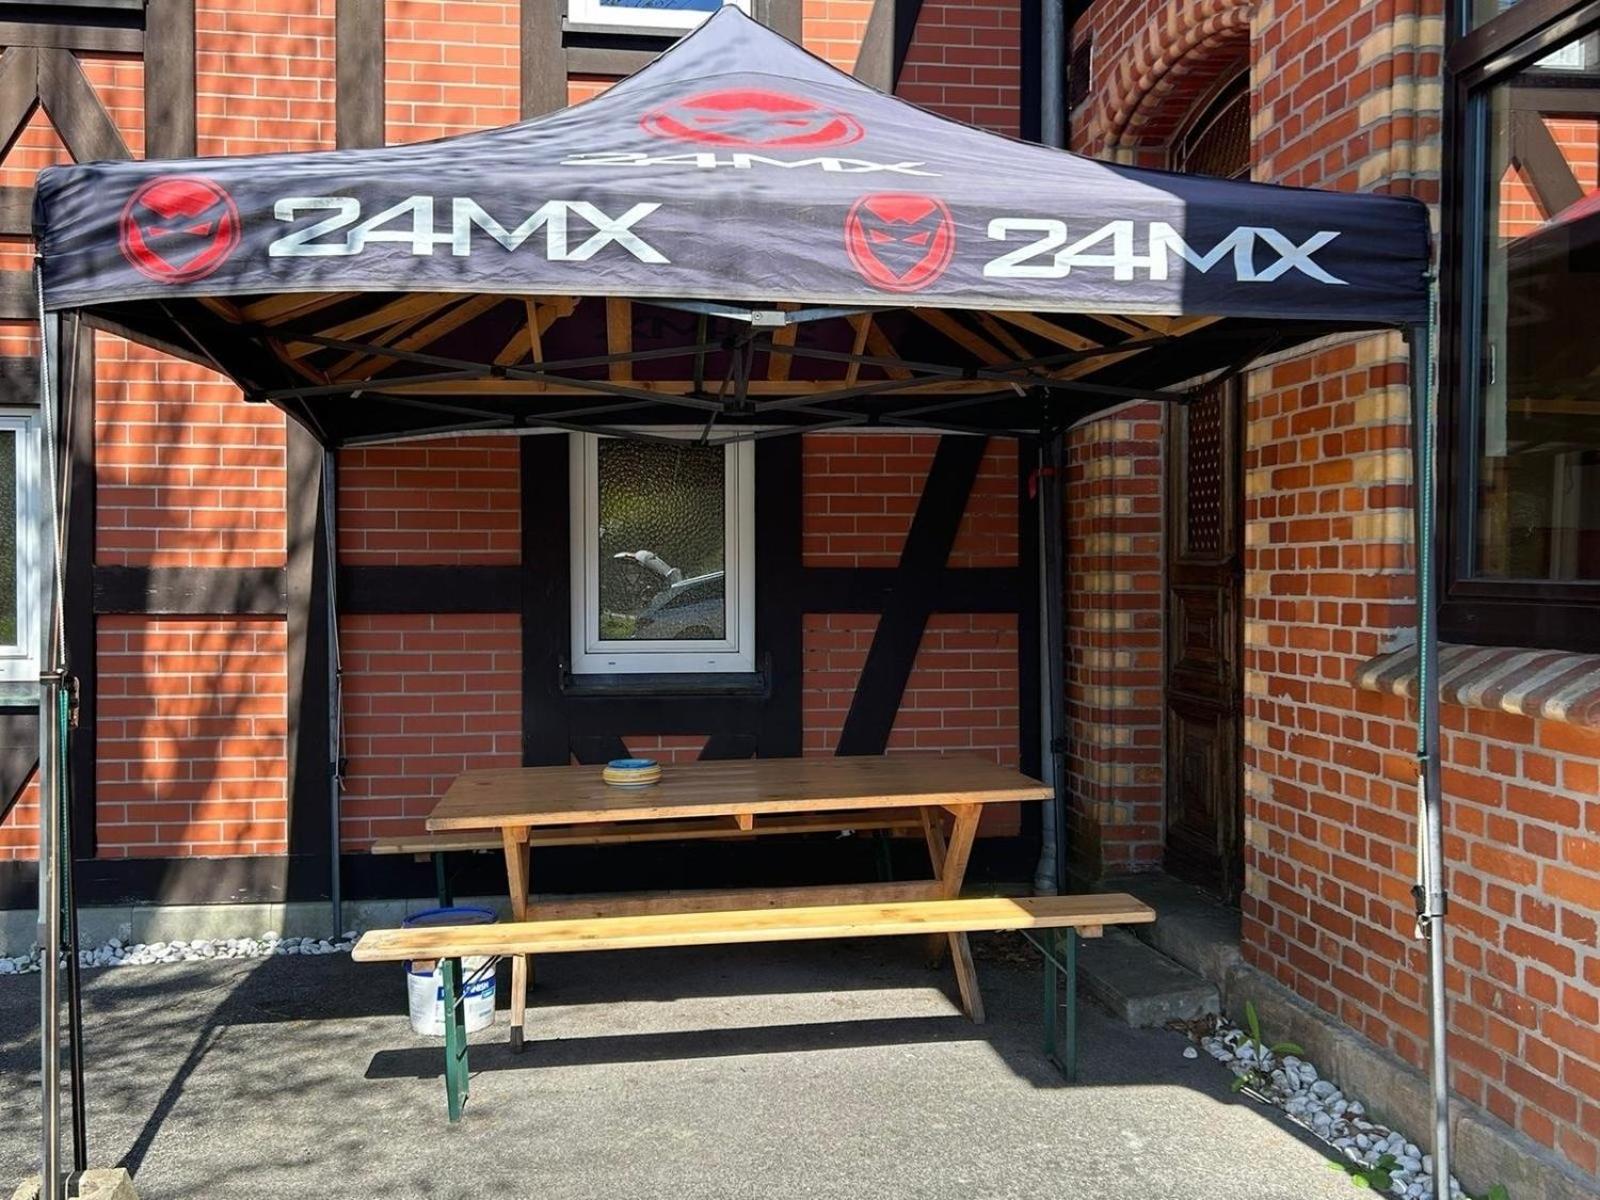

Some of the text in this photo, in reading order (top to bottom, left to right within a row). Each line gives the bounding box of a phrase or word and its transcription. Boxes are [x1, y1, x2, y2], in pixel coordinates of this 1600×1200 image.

[560, 152, 943, 177] 24MX
[268, 195, 671, 265] 24MX
[983, 217, 1349, 286] 24MX
